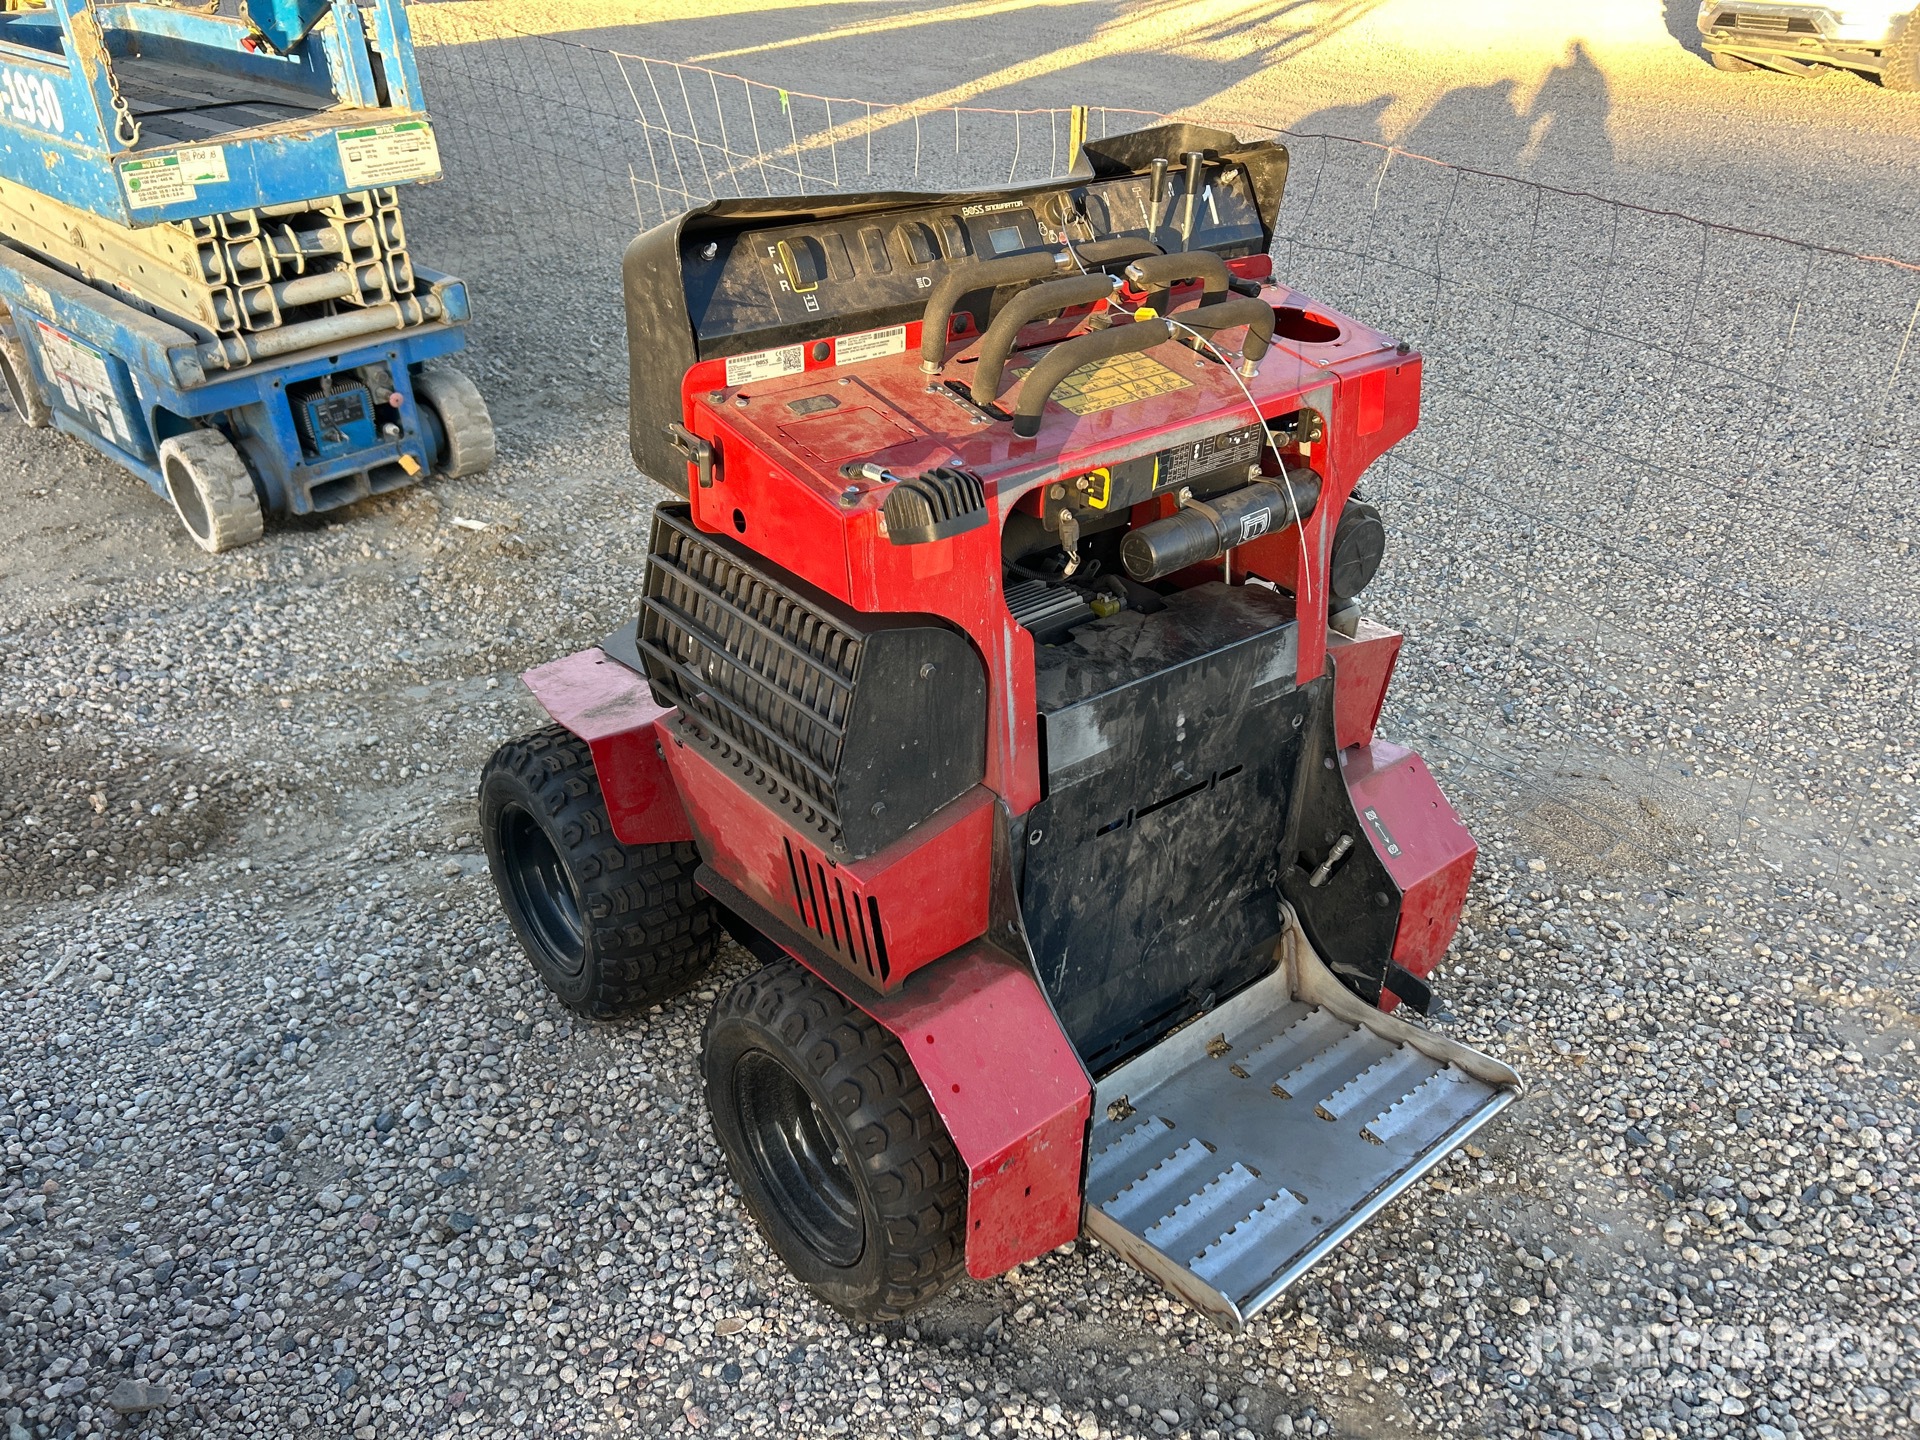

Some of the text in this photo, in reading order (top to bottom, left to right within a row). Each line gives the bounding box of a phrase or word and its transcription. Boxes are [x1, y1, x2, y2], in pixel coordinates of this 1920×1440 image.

[0, 68, 65, 133] -1930
[961, 205, 985, 216] BOSS
[1202, 184, 1220, 225] 1
[767, 246, 776, 258] F
[773, 262, 785, 275] N
[779, 280, 791, 292] R
